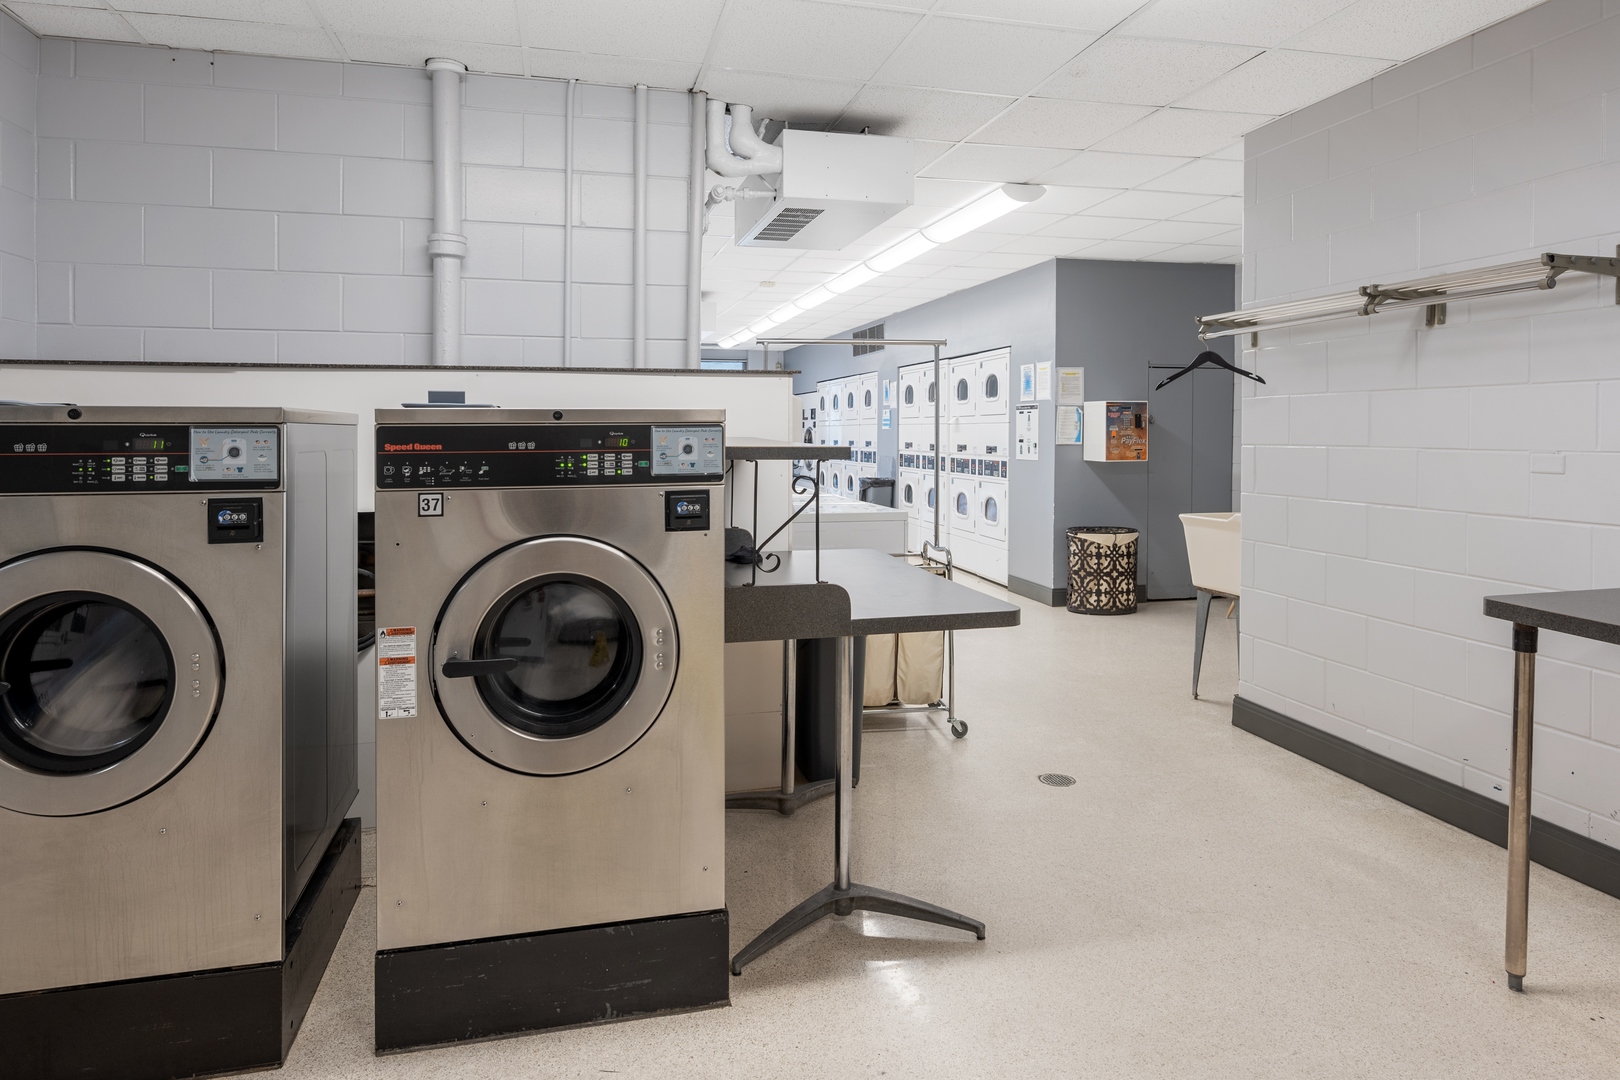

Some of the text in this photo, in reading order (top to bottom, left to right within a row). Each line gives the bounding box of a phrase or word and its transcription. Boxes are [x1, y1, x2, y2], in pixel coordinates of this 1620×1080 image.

[153, 440, 164, 449] 11
[1121, 437, 1146, 445] PayFlex
[422, 498, 440, 512] 37
